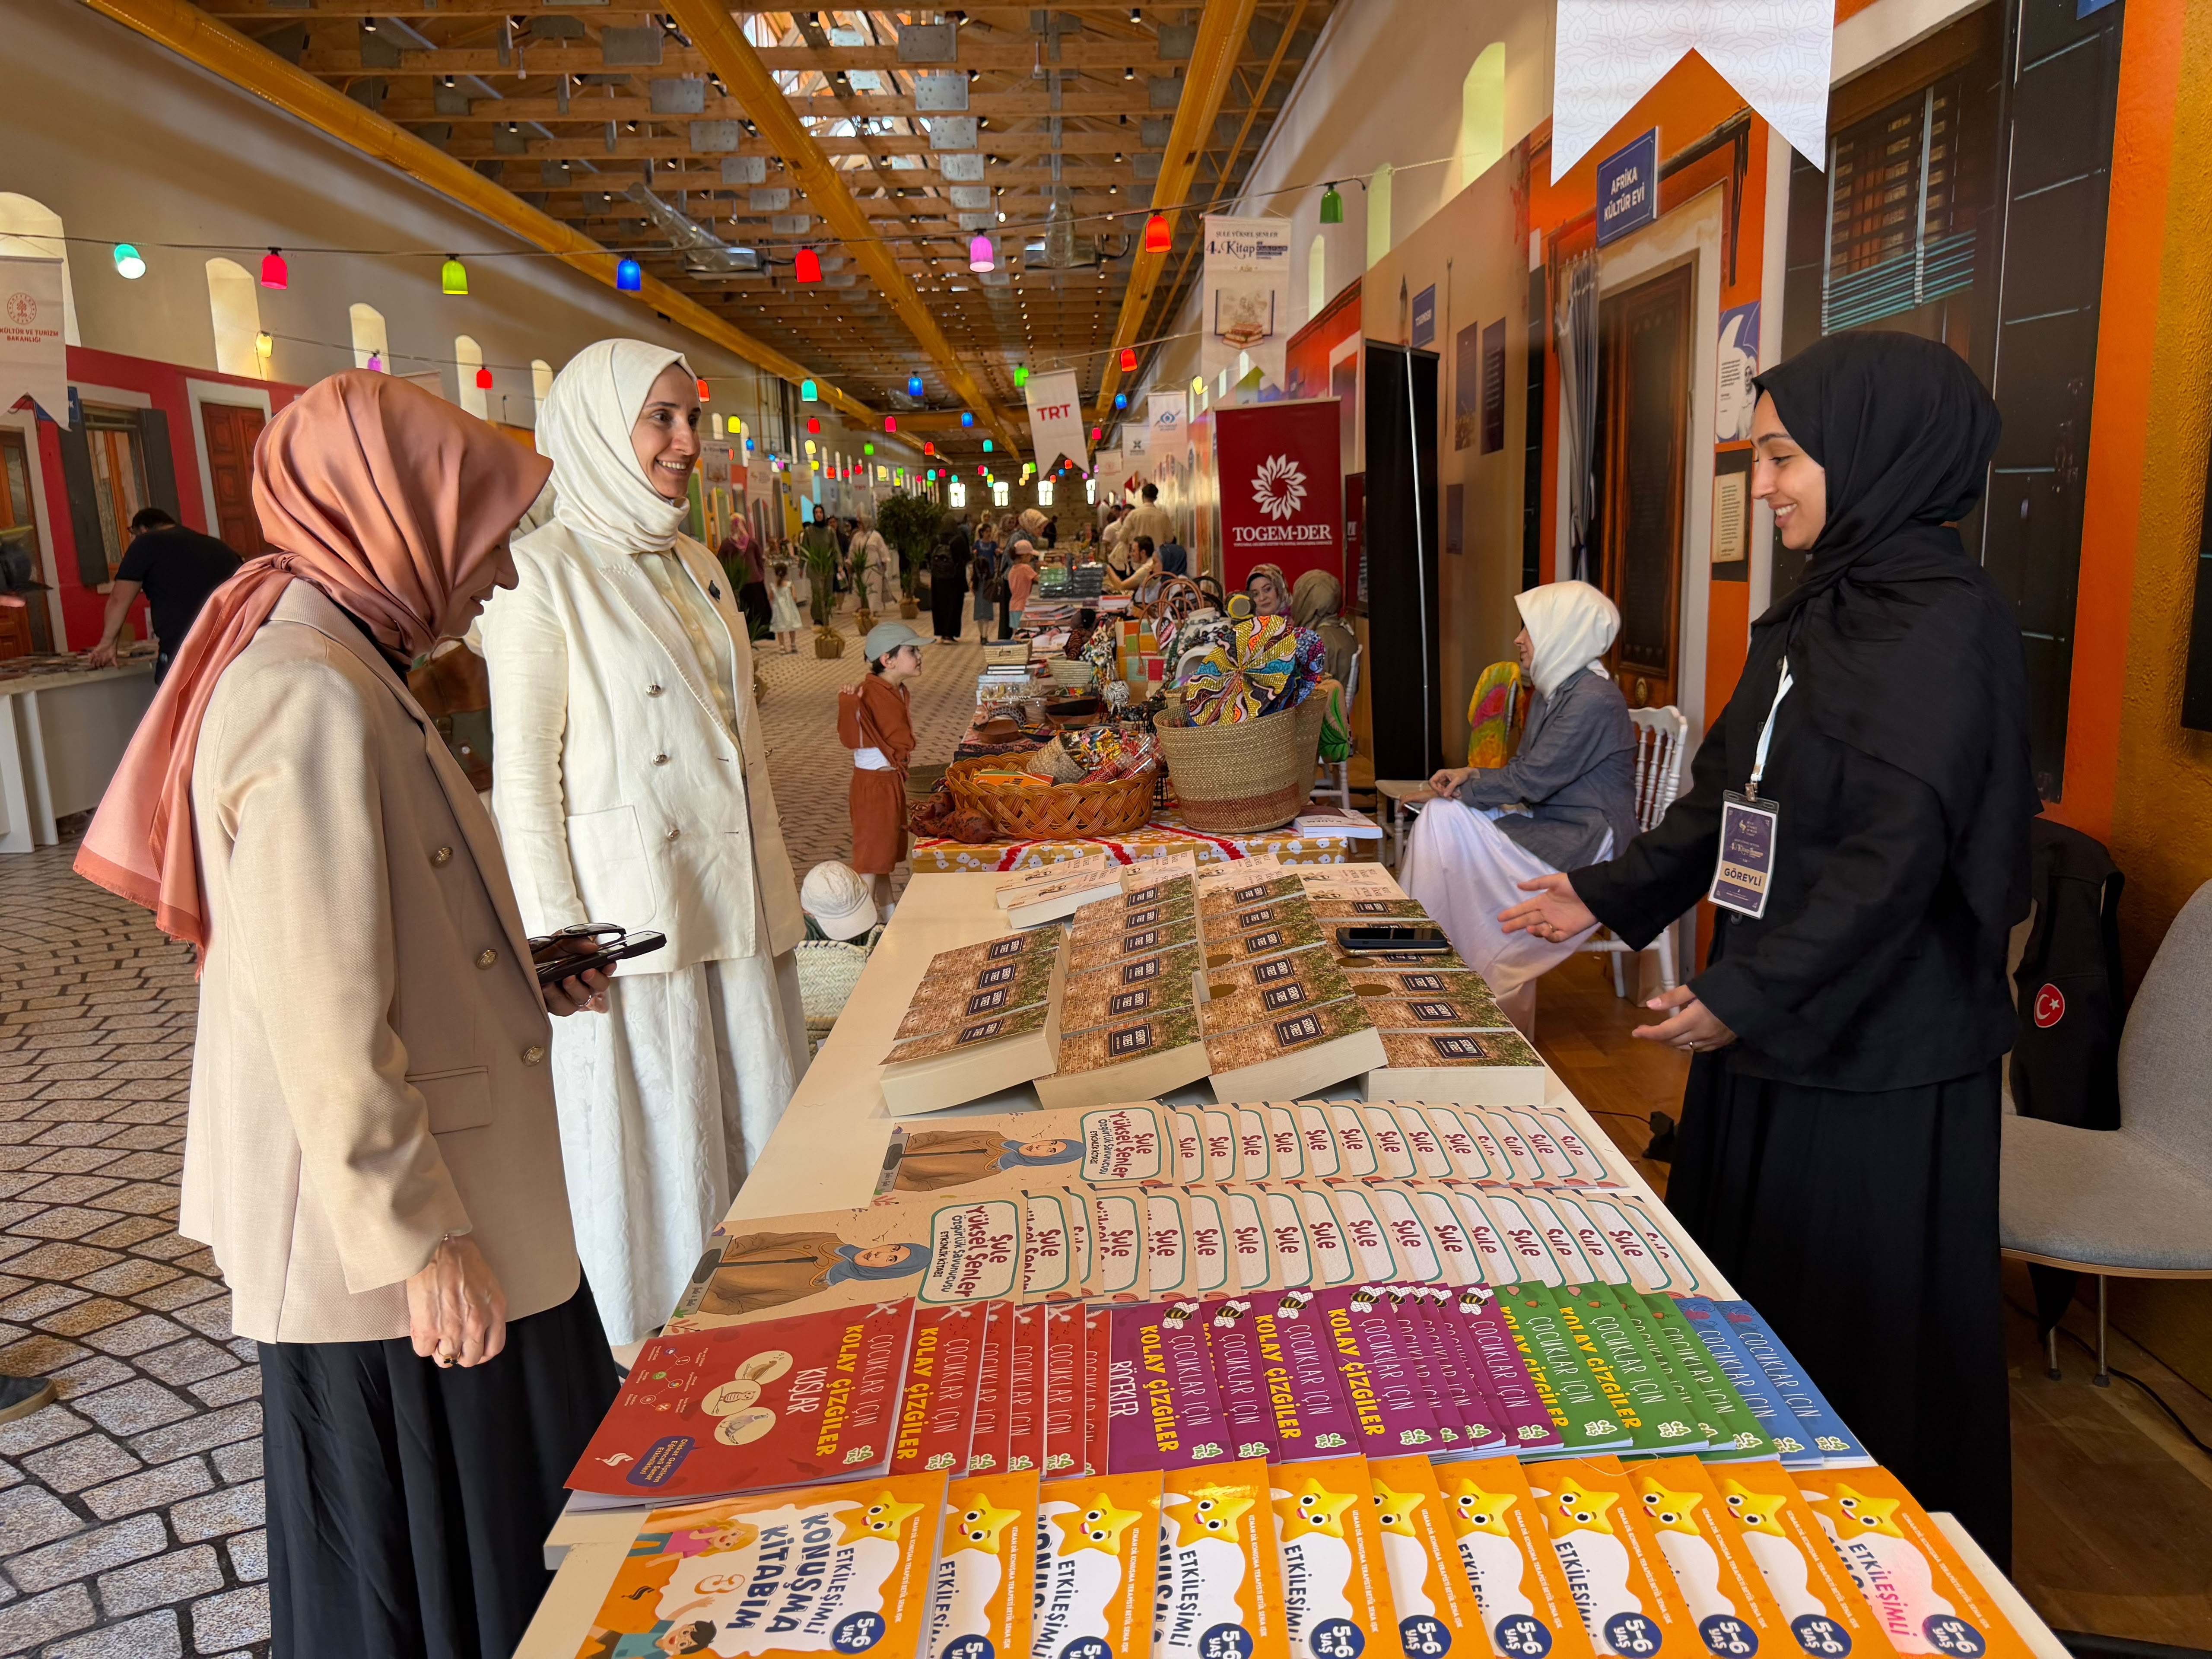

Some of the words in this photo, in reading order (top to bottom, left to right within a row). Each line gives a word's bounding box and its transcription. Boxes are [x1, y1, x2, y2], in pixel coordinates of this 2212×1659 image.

[1611, 167, 1638, 195] AFRİKA
[1604, 193, 1630, 222] KÜLTÜR
[1632, 181, 1645, 206] EVİ
[1206, 241, 1221, 254] 4.
[1221, 241, 1255, 259] Kitap
[1036, 403, 1071, 421] TRT
[1232, 524, 1332, 542] TOGEM-DER
[1724, 868, 1762, 887] GÖREVLİ
[1276, 991, 1287, 1002] STREET
[1287, 986, 1300, 1000] SERENITY
[1123, 1034, 1133, 1047] STREET
[1135, 1029, 1146, 1045] SERENITY
[1290, 1023, 1303, 1037] STREET
[1301, 1018, 1316, 1035] SERENITY
[1447, 1041, 1463, 1052] STREET
[1459, 1039, 1478, 1054] SERENITY
[1090, 1131, 1101, 1149] ETKİNLİK
[1098, 1119, 1114, 1143] Özgürlük
[1109, 1111, 1133, 1145] Yüksel
[1306, 1130, 1327, 1151] Şule
[1377, 1131, 1400, 1153] Şule
[1090, 1150, 1101, 1164] KİTABI
[1132, 1133, 1154, 1154] Şule
[1242, 1135, 1262, 1155] Şule
[1445, 1133, 1471, 1154] Şule
[1111, 1147, 1135, 1178] Şenler
[950, 1215, 966, 1248] Özgürlük
[966, 1205, 989, 1251] Yüksel
[1193, 1228, 1218, 1255] Şule
[1273, 1227, 1299, 1253] Şule
[1348, 1220, 1377, 1247] Şule
[939, 1231, 951, 1257] ETKİNLİK
[987, 1234, 1013, 1263] Şule
[1038, 1228, 1061, 1257] Şule
[1111, 1229, 1134, 1257] Şule
[1155, 1229, 1178, 1256] Şule
[1507, 1229, 1541, 1257] Şule
[933, 1258, 949, 1278] KİTABI
[954, 1253, 988, 1297] Şenler
[1255, 1314, 1283, 1362] KOLAY
[1328, 1308, 1360, 1357] KOLAY
[836, 1325, 864, 1372] KOLAY
[913, 1327, 939, 1377] KOLAY
[1139, 1325, 1166, 1373] KOLAY
[1284, 1325, 1325, 1385] ÇOCUKLAR
[1526, 1317, 1578, 1375] ÇOCUKLAR
[1560, 1379, 1595, 1404] İÇİN
[1589, 1316, 1646, 1374] ÇOCUKLAR
[1630, 1378, 1666, 1404] İÇİN
[860, 1335, 893, 1395] ÇOCUKLAR
[938, 1339, 969, 1401] ÇOCUKLAR
[1168, 1335, 1205, 1397] ÇOCUKLAR
[1219, 1334, 1255, 1395] ÇOCUKLAR
[1359, 1318, 1404, 1379] ÇOCUKLAR
[1382, 1383, 1416, 1411] İÇİN
[1469, 1321, 1517, 1379] ÇOCUKLAR
[1497, 1384, 1531, 1408] İÇİN
[1738, 1332, 1799, 1389] ÇOCUKLAR
[1783, 1393, 1822, 1417] İÇİN
[785, 1367, 828, 1415] KUŞLAR
[1265, 1367, 1302, 1439] ÇİZGİLER
[1300, 1390, 1333, 1415] İÇİN
[1338, 1361, 1386, 1436] ÇİZGİLER
[1587, 1358, 1642, 1428] ÇİZGİLER
[816, 1379, 855, 1456] ÇİZGİLER
[852, 1399, 881, 1427] İÇİN
[896, 1383, 934, 1459] ÇİZGİLER
[931, 1405, 960, 1433] İÇİN
[1142, 1379, 1179, 1452] ÇİZGİLER
[1184, 1401, 1212, 1426] İÇİN
[1232, 1400, 1260, 1424] İÇİN
[639, 1447, 664, 1474] Etkinlikleri
[657, 1441, 678, 1465] Eğlenceli
[672, 1439, 688, 1456] Dikkat
[645, 1465, 660, 1480] Sanat
[653, 1457, 675, 1482] Geliştiren
[1352, 1510, 1360, 1529] UZMAN
[1355, 1529, 1363, 1537] DİL
[1357, 1537, 1367, 1564] KONUŞMA
[694, 1574, 745, 1594] 3
[725, 1525, 794, 1629] KİTABIM
[765, 1513, 829, 1633] KONUŞMA
[803, 1548, 856, 1635] ETKİLEŞİMLİ
[1168, 1550, 1206, 1648] ETKİLEŞİMLİ
[1365, 1589, 1376, 1605] BETÜL
[1848, 1543, 1918, 1637] ETKİLEŞİMLİ
[1124, 1610, 1133, 1625] BETÜL
[1368, 1605, 1376, 1621] SENA
[852, 1618, 875, 1647] 5-6
[1332, 1626, 1354, 1658] 5-6
[1417, 1622, 1442, 1654] 5-6
[1516, 1622, 1541, 1654] 5-6
[1626, 1621, 1653, 1652] 5-6
[1720, 1622, 1749, 1654] 5-6
[1812, 1622, 1844, 1653] 5-6
[1942, 1621, 1978, 1653] 5-6
